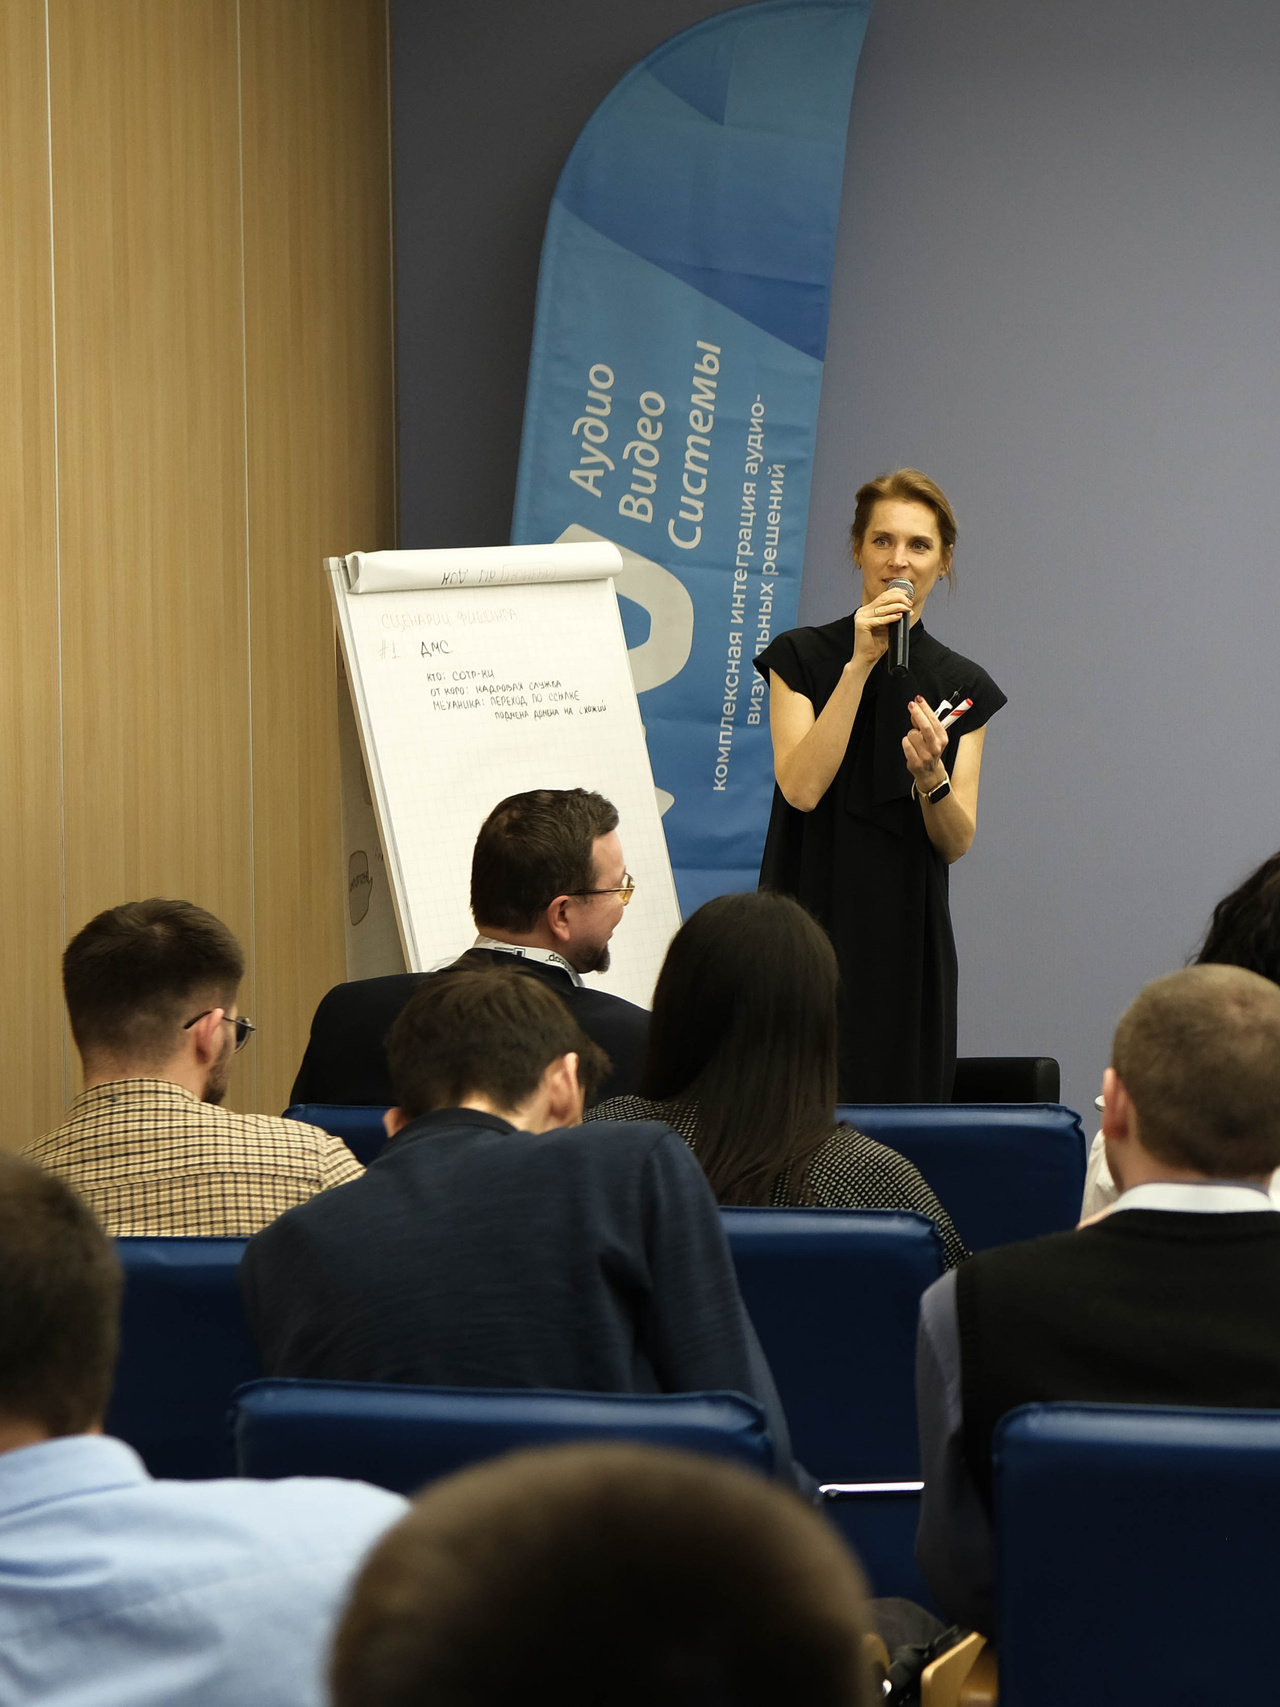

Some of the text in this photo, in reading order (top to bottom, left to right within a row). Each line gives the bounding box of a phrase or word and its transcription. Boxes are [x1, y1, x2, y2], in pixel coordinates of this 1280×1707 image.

[569, 363, 615, 499] Аудио
[618, 390, 666, 524] Видео
[667, 340, 722, 550] Системы
[420, 639, 454, 659] ДМС
[712, 393, 766, 791] комплексная интеграция аудио-
[747, 463, 787, 725] визульных решений
